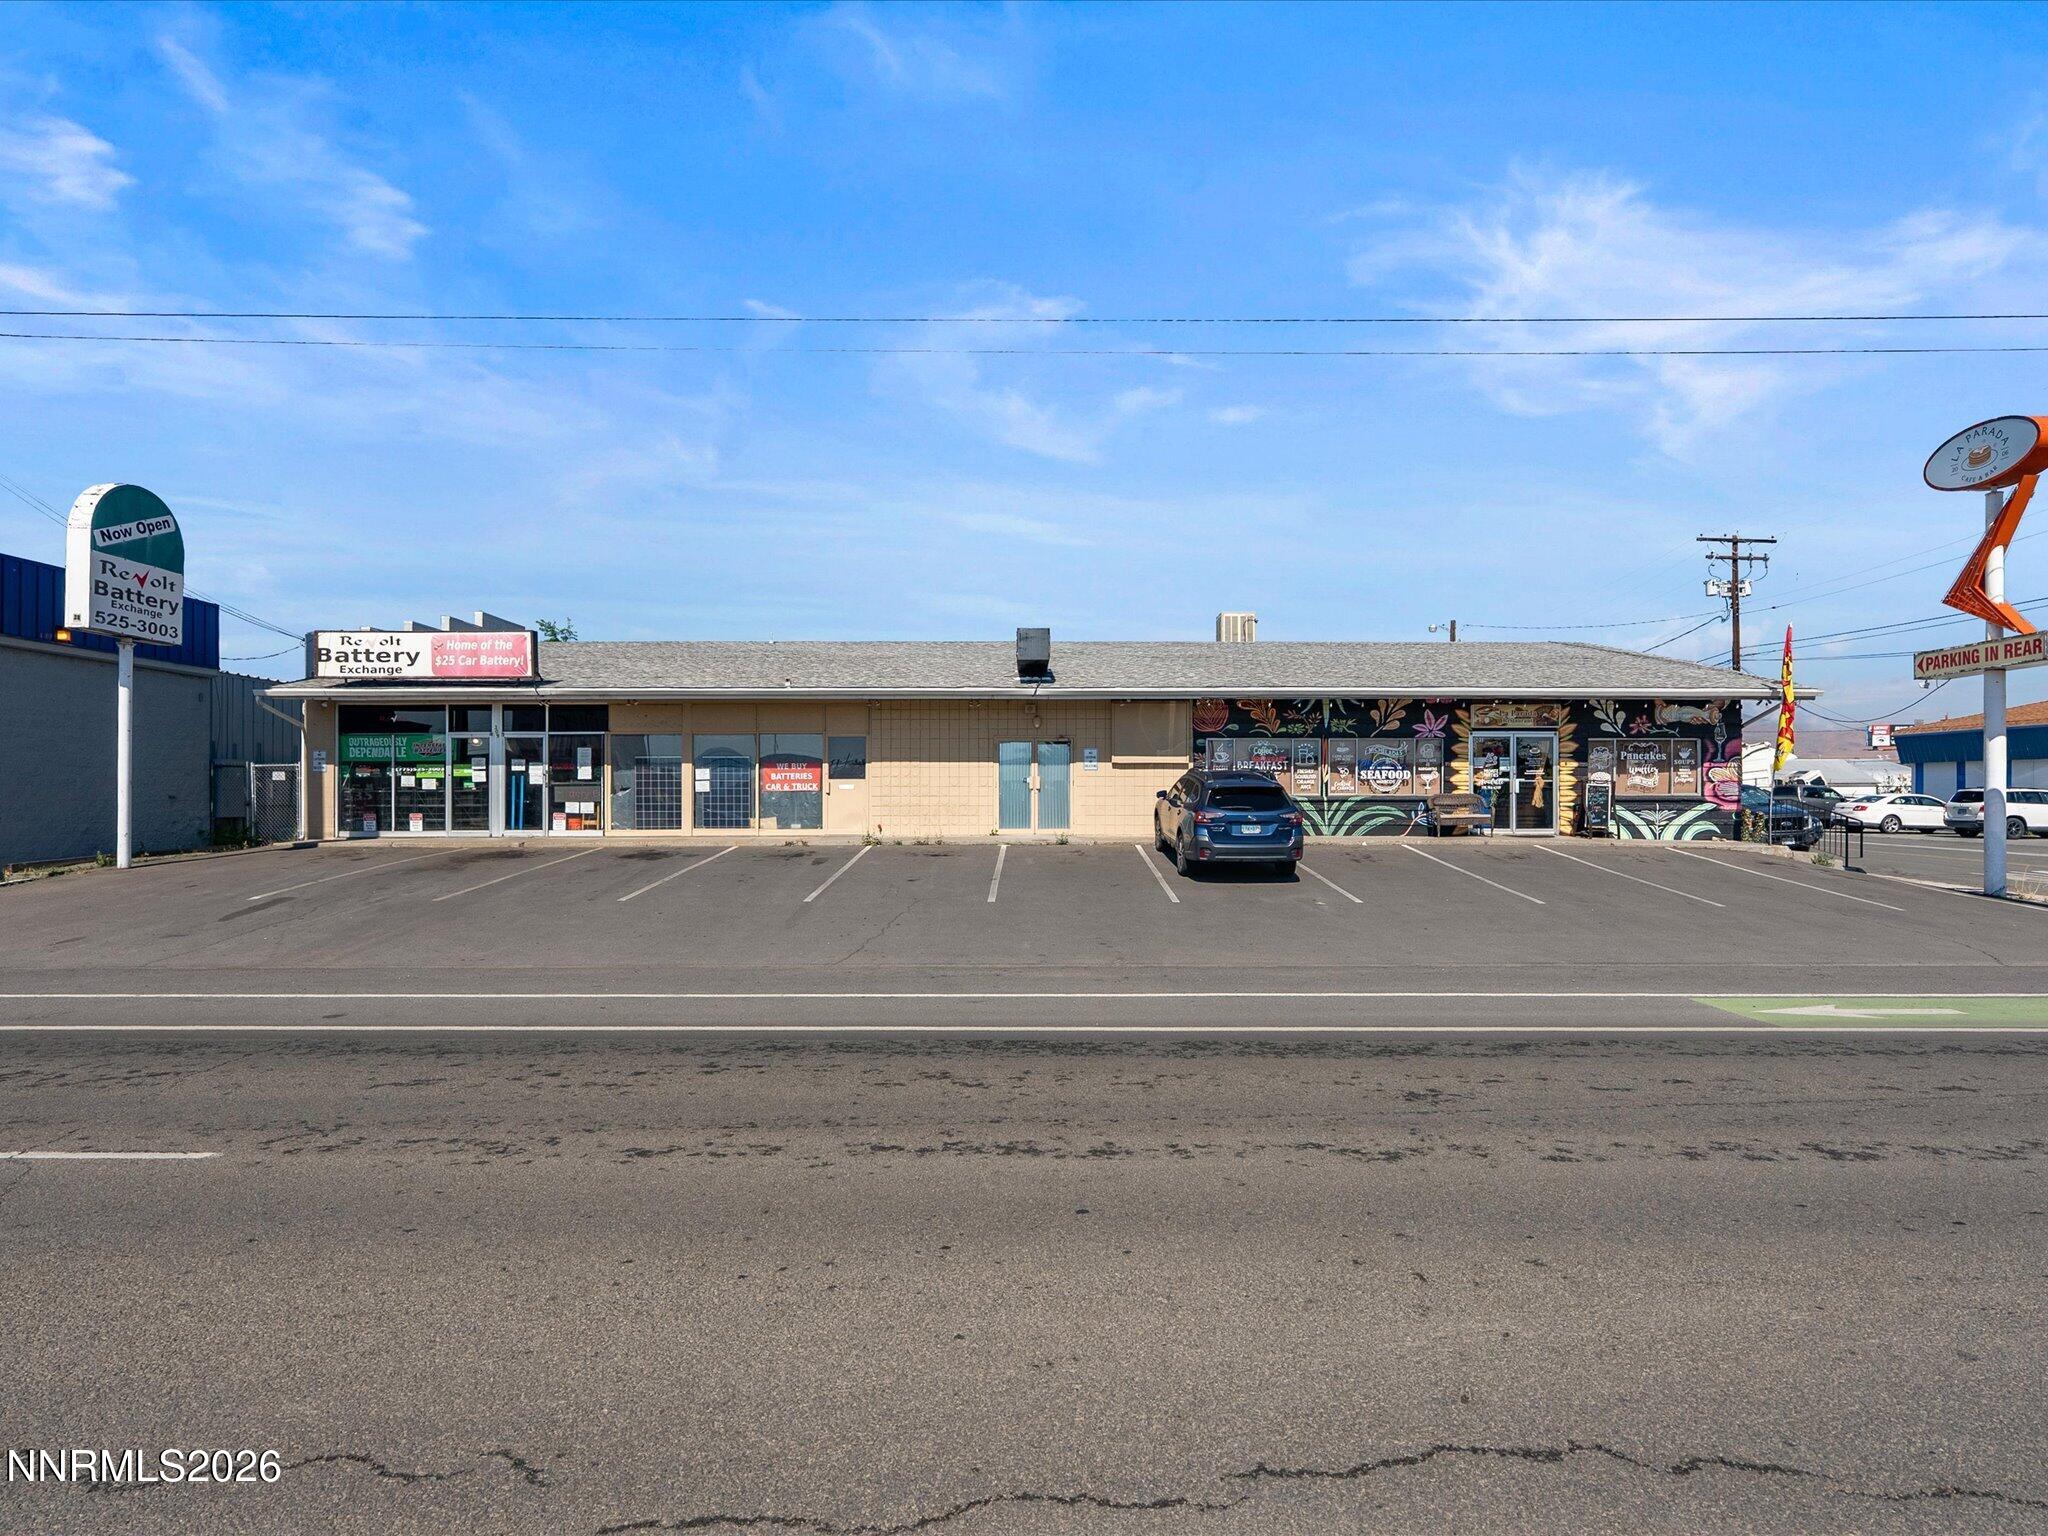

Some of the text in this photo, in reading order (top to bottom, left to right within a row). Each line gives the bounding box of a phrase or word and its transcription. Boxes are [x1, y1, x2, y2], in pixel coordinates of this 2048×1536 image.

[1951, 426, 2010, 462] LA PARADA
[100, 517, 171, 543] Now Open
[94, 580, 179, 615] Battery
[111, 600, 163, 619] Exchange
[94, 610, 178, 639] 525-3003
[446, 639, 513, 651] Home of the
[318, 647, 420, 667] Battery
[1926, 637, 2043, 671] PARKING IN REAR
[434, 655, 525, 668] $25 Car Battery!
[339, 664, 403, 676] Exchange
[349, 747, 407, 757] DEPENDALE
[1620, 751, 1667, 760] Pancakes
[1237, 761, 1288, 770] BREAKFAST
[770, 772, 813, 781] BATTERIES
[1360, 770, 1411, 780] SEAFOOD
[765, 783, 819, 791] CAR & TRUCK
